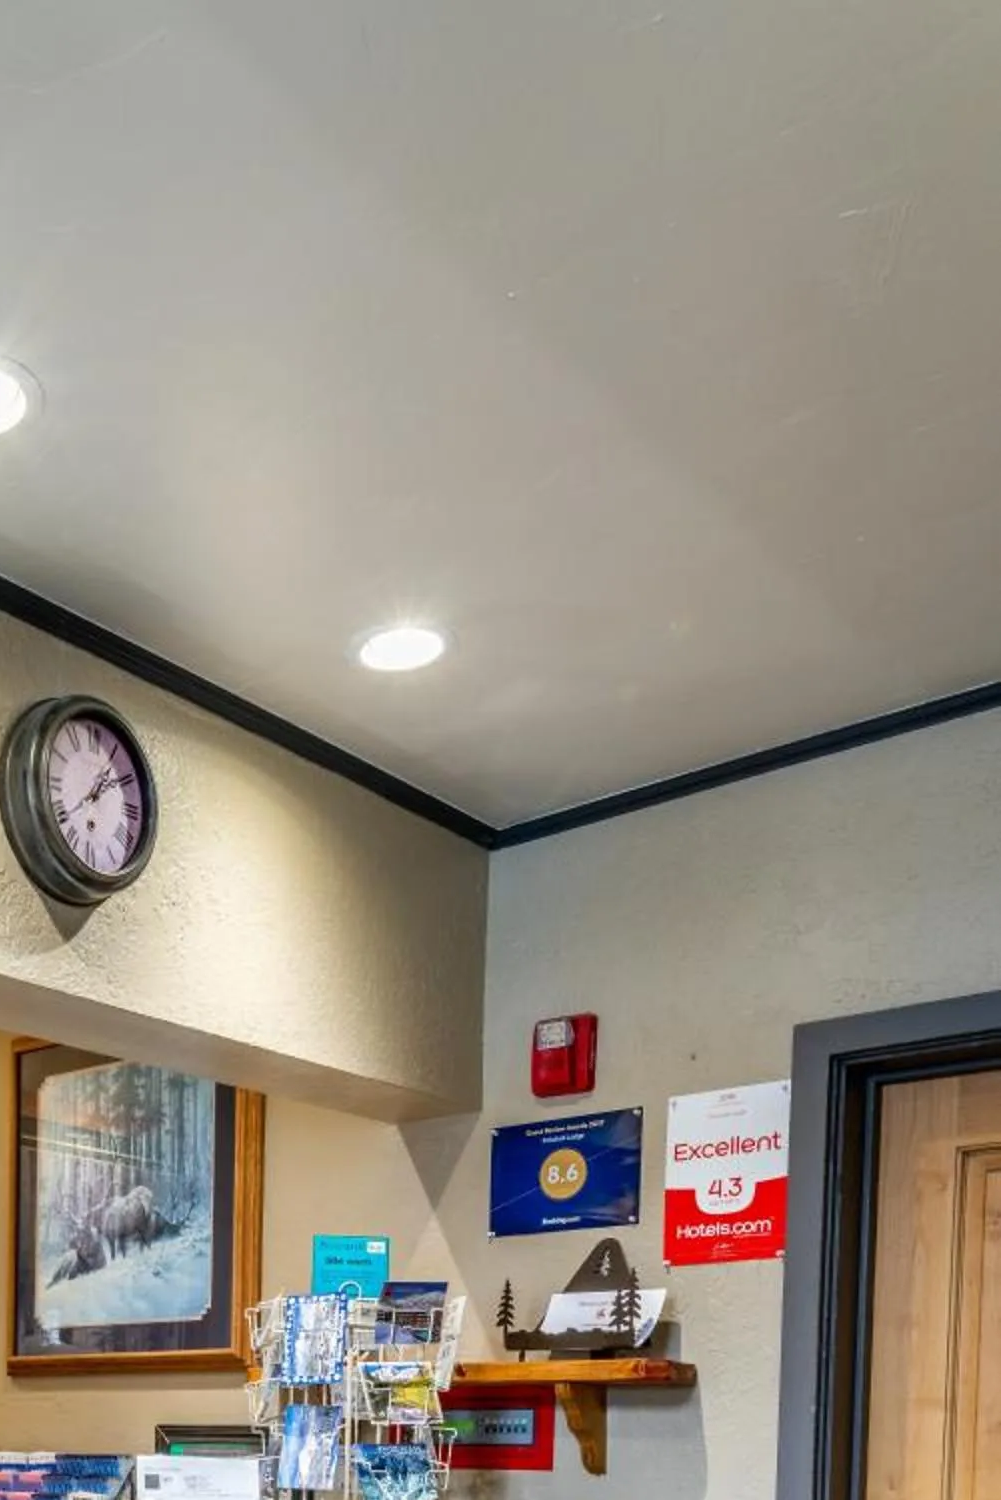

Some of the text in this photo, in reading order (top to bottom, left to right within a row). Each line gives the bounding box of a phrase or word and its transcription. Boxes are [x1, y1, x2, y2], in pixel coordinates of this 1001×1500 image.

[674, 1130, 782, 1162] Excellent
[708, 1177, 743, 1198] 4.3
[676, 1219, 773, 1240] Hotels.com
